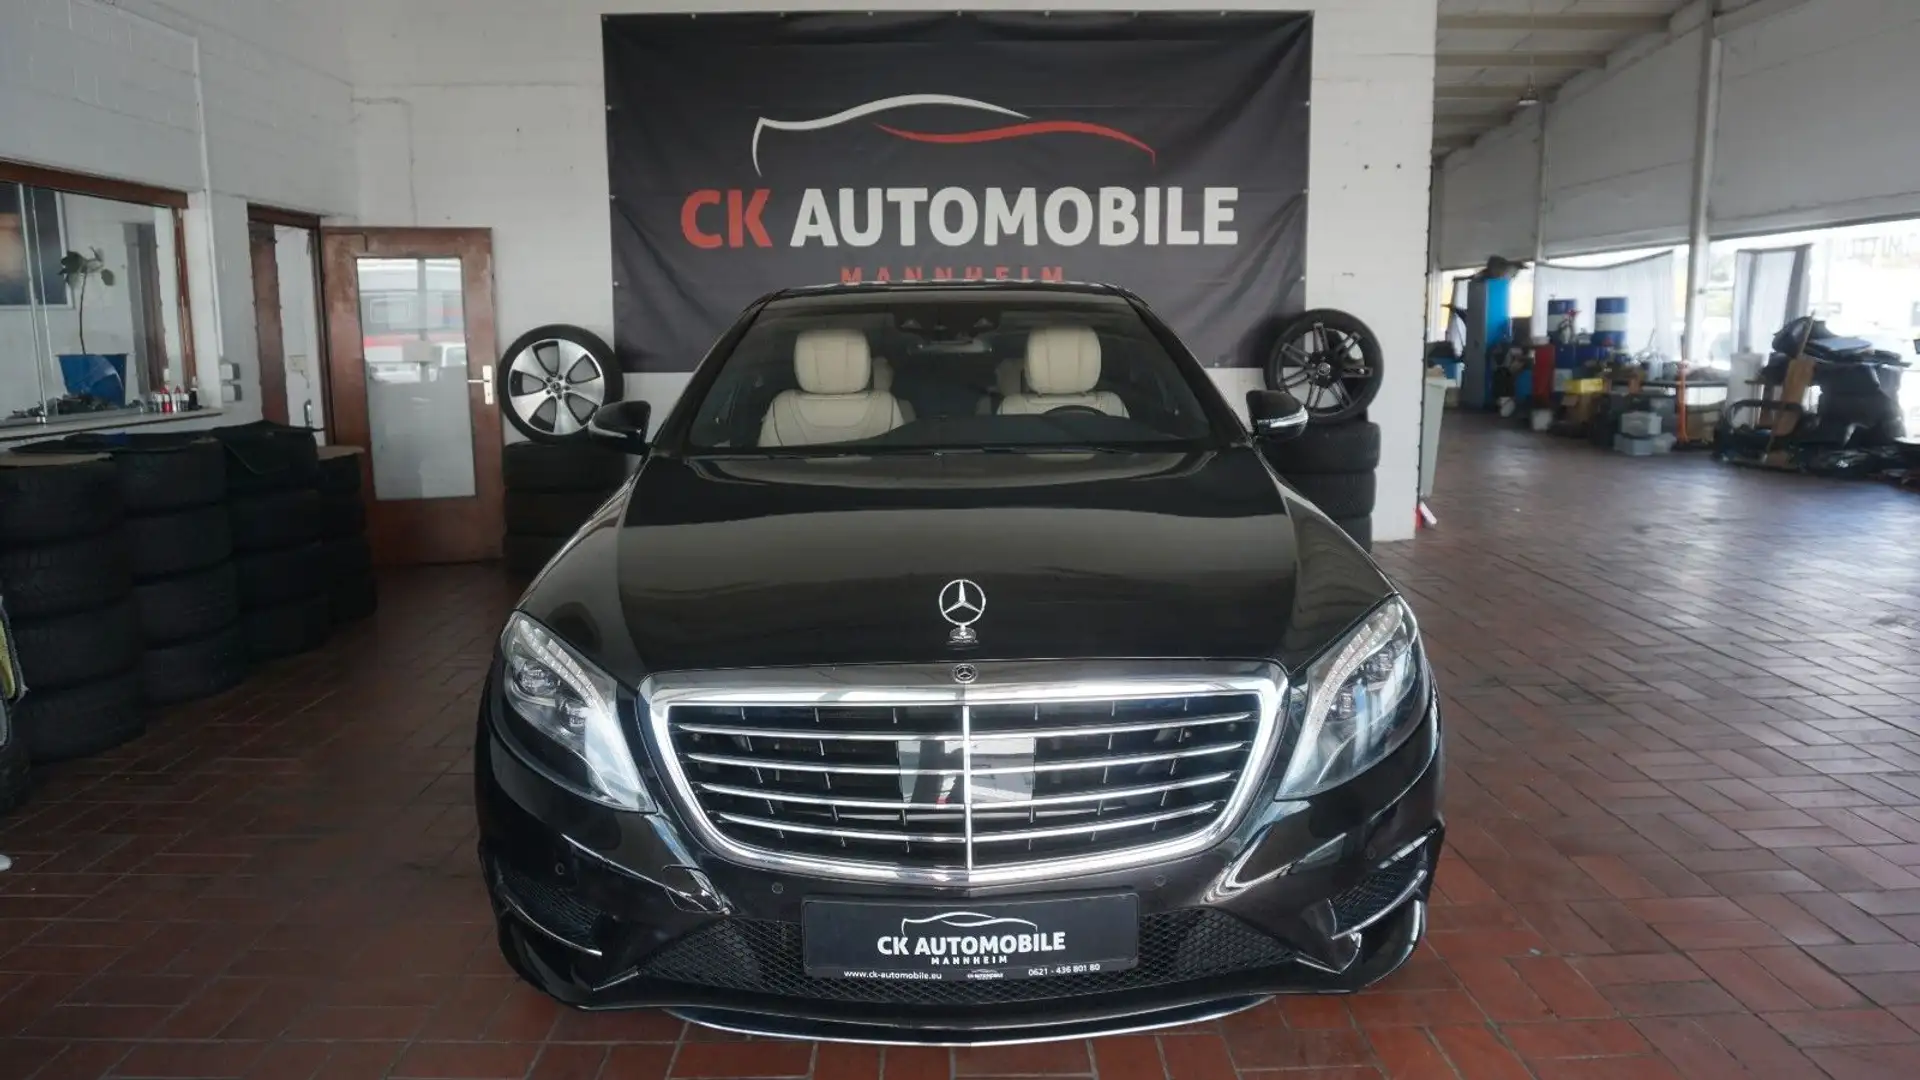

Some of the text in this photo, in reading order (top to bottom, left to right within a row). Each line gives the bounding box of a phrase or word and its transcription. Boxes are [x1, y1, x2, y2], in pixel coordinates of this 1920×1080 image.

[681, 186, 1239, 249] CK AUTOMOBILE
[877, 932, 1066, 956] CK AUTOMOBILE
[931, 955, 1008, 965] MANNHEIM
[843, 970, 942, 980] www.ck-automobile.eu
[1028, 967, 1048, 976] 0621
[1056, 965, 1072, 974] 436
[1072, 964, 1087, 973] 801
[1089, 963, 1101, 972] 80
